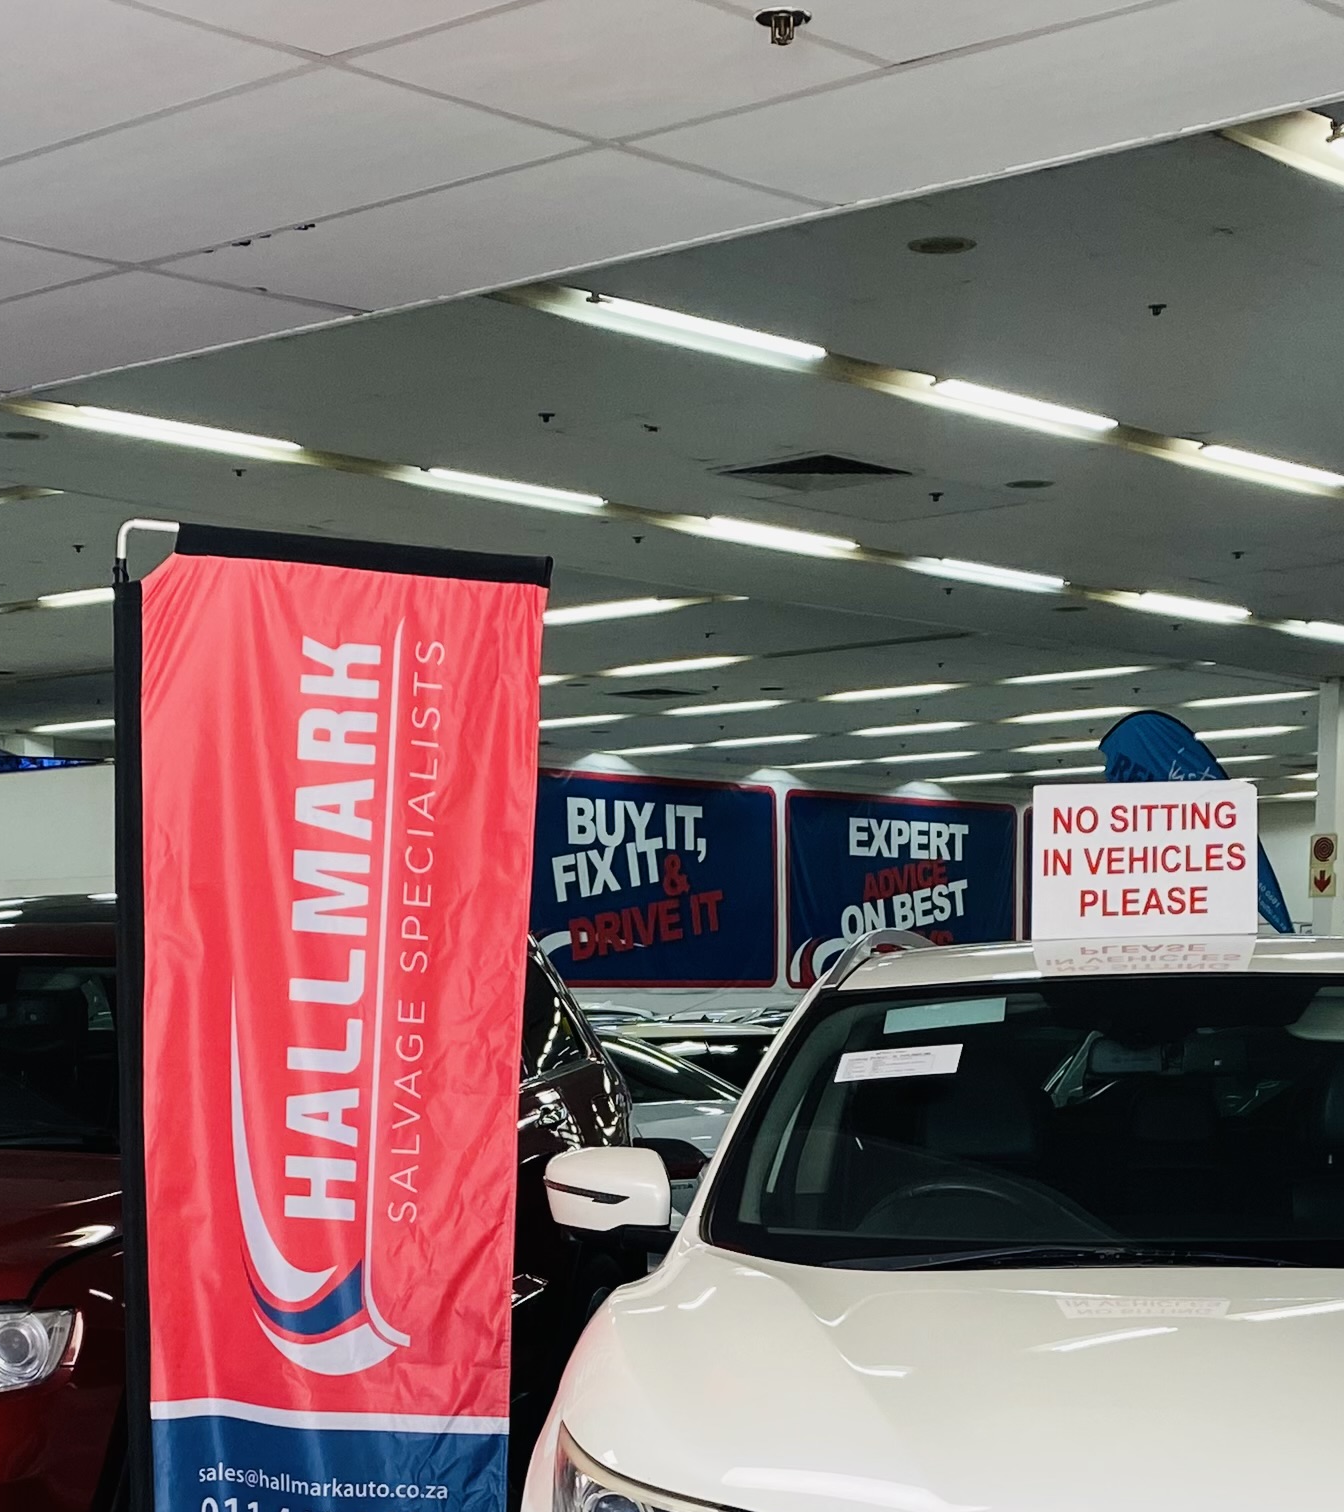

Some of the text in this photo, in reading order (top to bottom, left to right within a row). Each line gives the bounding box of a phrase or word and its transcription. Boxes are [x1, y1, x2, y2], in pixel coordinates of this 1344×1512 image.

[567, 797, 706, 863] BUY IT,
[849, 817, 969, 861] EXPERT
[1053, 801, 1237, 834] NO SITTING
[552, 837, 690, 903] FIX IT &
[862, 859, 948, 904] ADVICE
[1043, 843, 1246, 876] IN VEHICLES
[284, 635, 382, 1222] HALLMARK
[568, 890, 724, 961] DRIVE IT
[841, 879, 968, 943] ON BEST
[1080, 886, 1208, 917] PLEASE
[387, 640, 445, 1223] SALVAGE SPECIALISTS
[198, 1462, 449, 1500] sales@hallmarkauto.co.za
